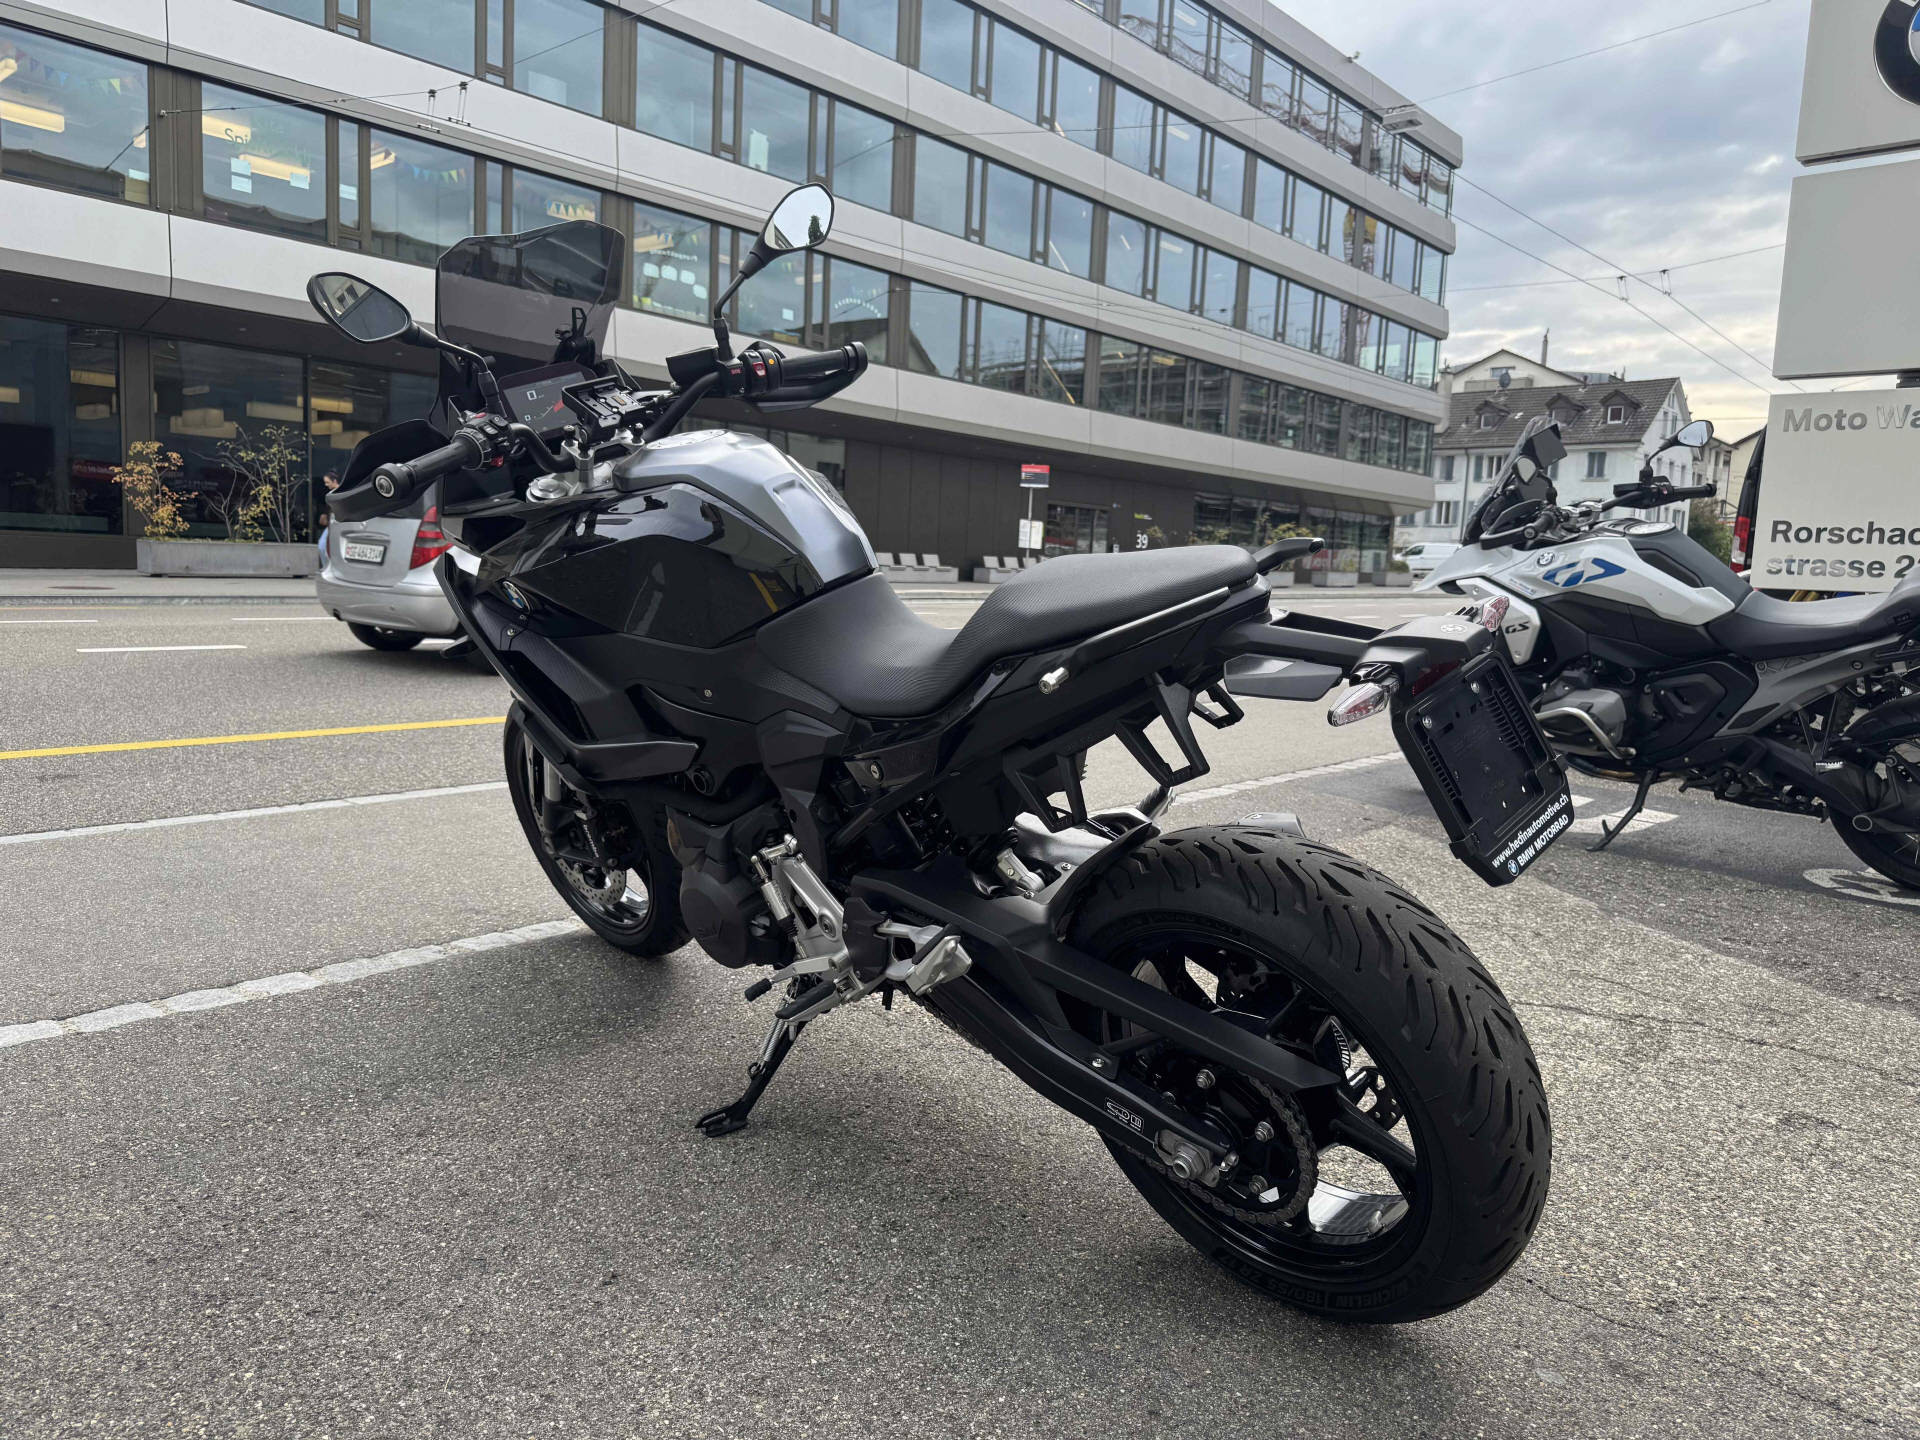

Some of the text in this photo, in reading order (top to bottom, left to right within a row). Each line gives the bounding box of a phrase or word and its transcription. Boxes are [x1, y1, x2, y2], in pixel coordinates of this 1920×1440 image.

[1783, 408, 1867, 432] Moto
[1135, 533, 1149, 549] 39
[1770, 519, 1920, 546] Rorschac
[1766, 554, 1886, 579] strasse
[1505, 621, 1530, 634] GS
[1491, 793, 1569, 868] www.hedinautomotive.ch
[1517, 814, 1569, 867] BMW MOTORRAD
